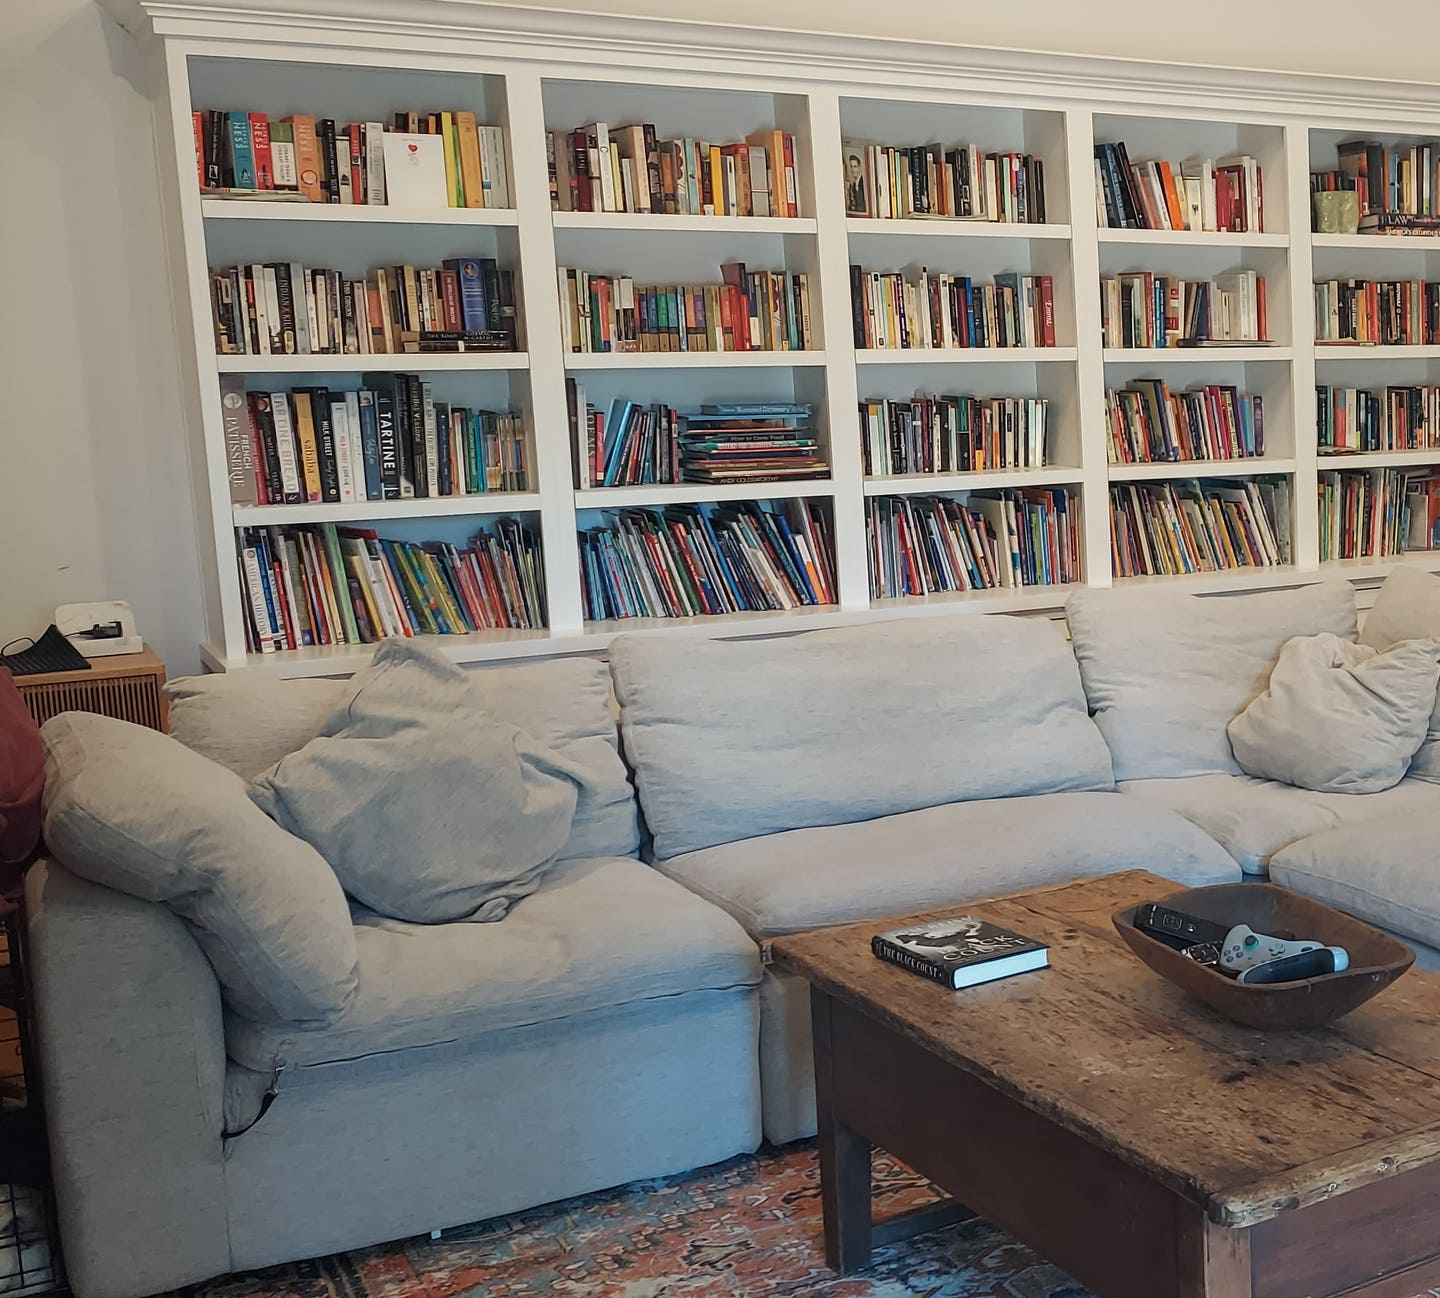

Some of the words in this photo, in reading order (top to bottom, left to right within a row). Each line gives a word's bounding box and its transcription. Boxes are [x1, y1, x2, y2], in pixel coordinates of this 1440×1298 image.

[233, 122, 245, 148] NESS
[252, 122, 265, 149] NESS
[1388, 215, 1409, 224] LAW
[280, 279, 291, 306] INDIAN
[491, 299, 500, 323] Poetry
[321, 420, 331, 436] MILK
[379, 412, 395, 469] TARTINE
[413, 412, 422, 442] Visions
[586, 407, 596, 457] POEMS
[226, 417, 244, 488] PATISSERIE
[240, 434, 252, 469] FRENCH
[267, 436, 275, 457] WATER
[273, 395, 288, 446] TARTINE
[281, 448, 297, 492] BREAD
[304, 439, 317, 474] sababa
[323, 436, 333, 457] STREET
[247, 563, 260, 601] AMERICAN
[254, 604, 267, 636] HISTORY
[883, 946, 895, 959] THE
[896, 951, 915, 968] BLACK
[916, 959, 938, 978] COUNT
[943, 938, 1025, 960] COUNT
